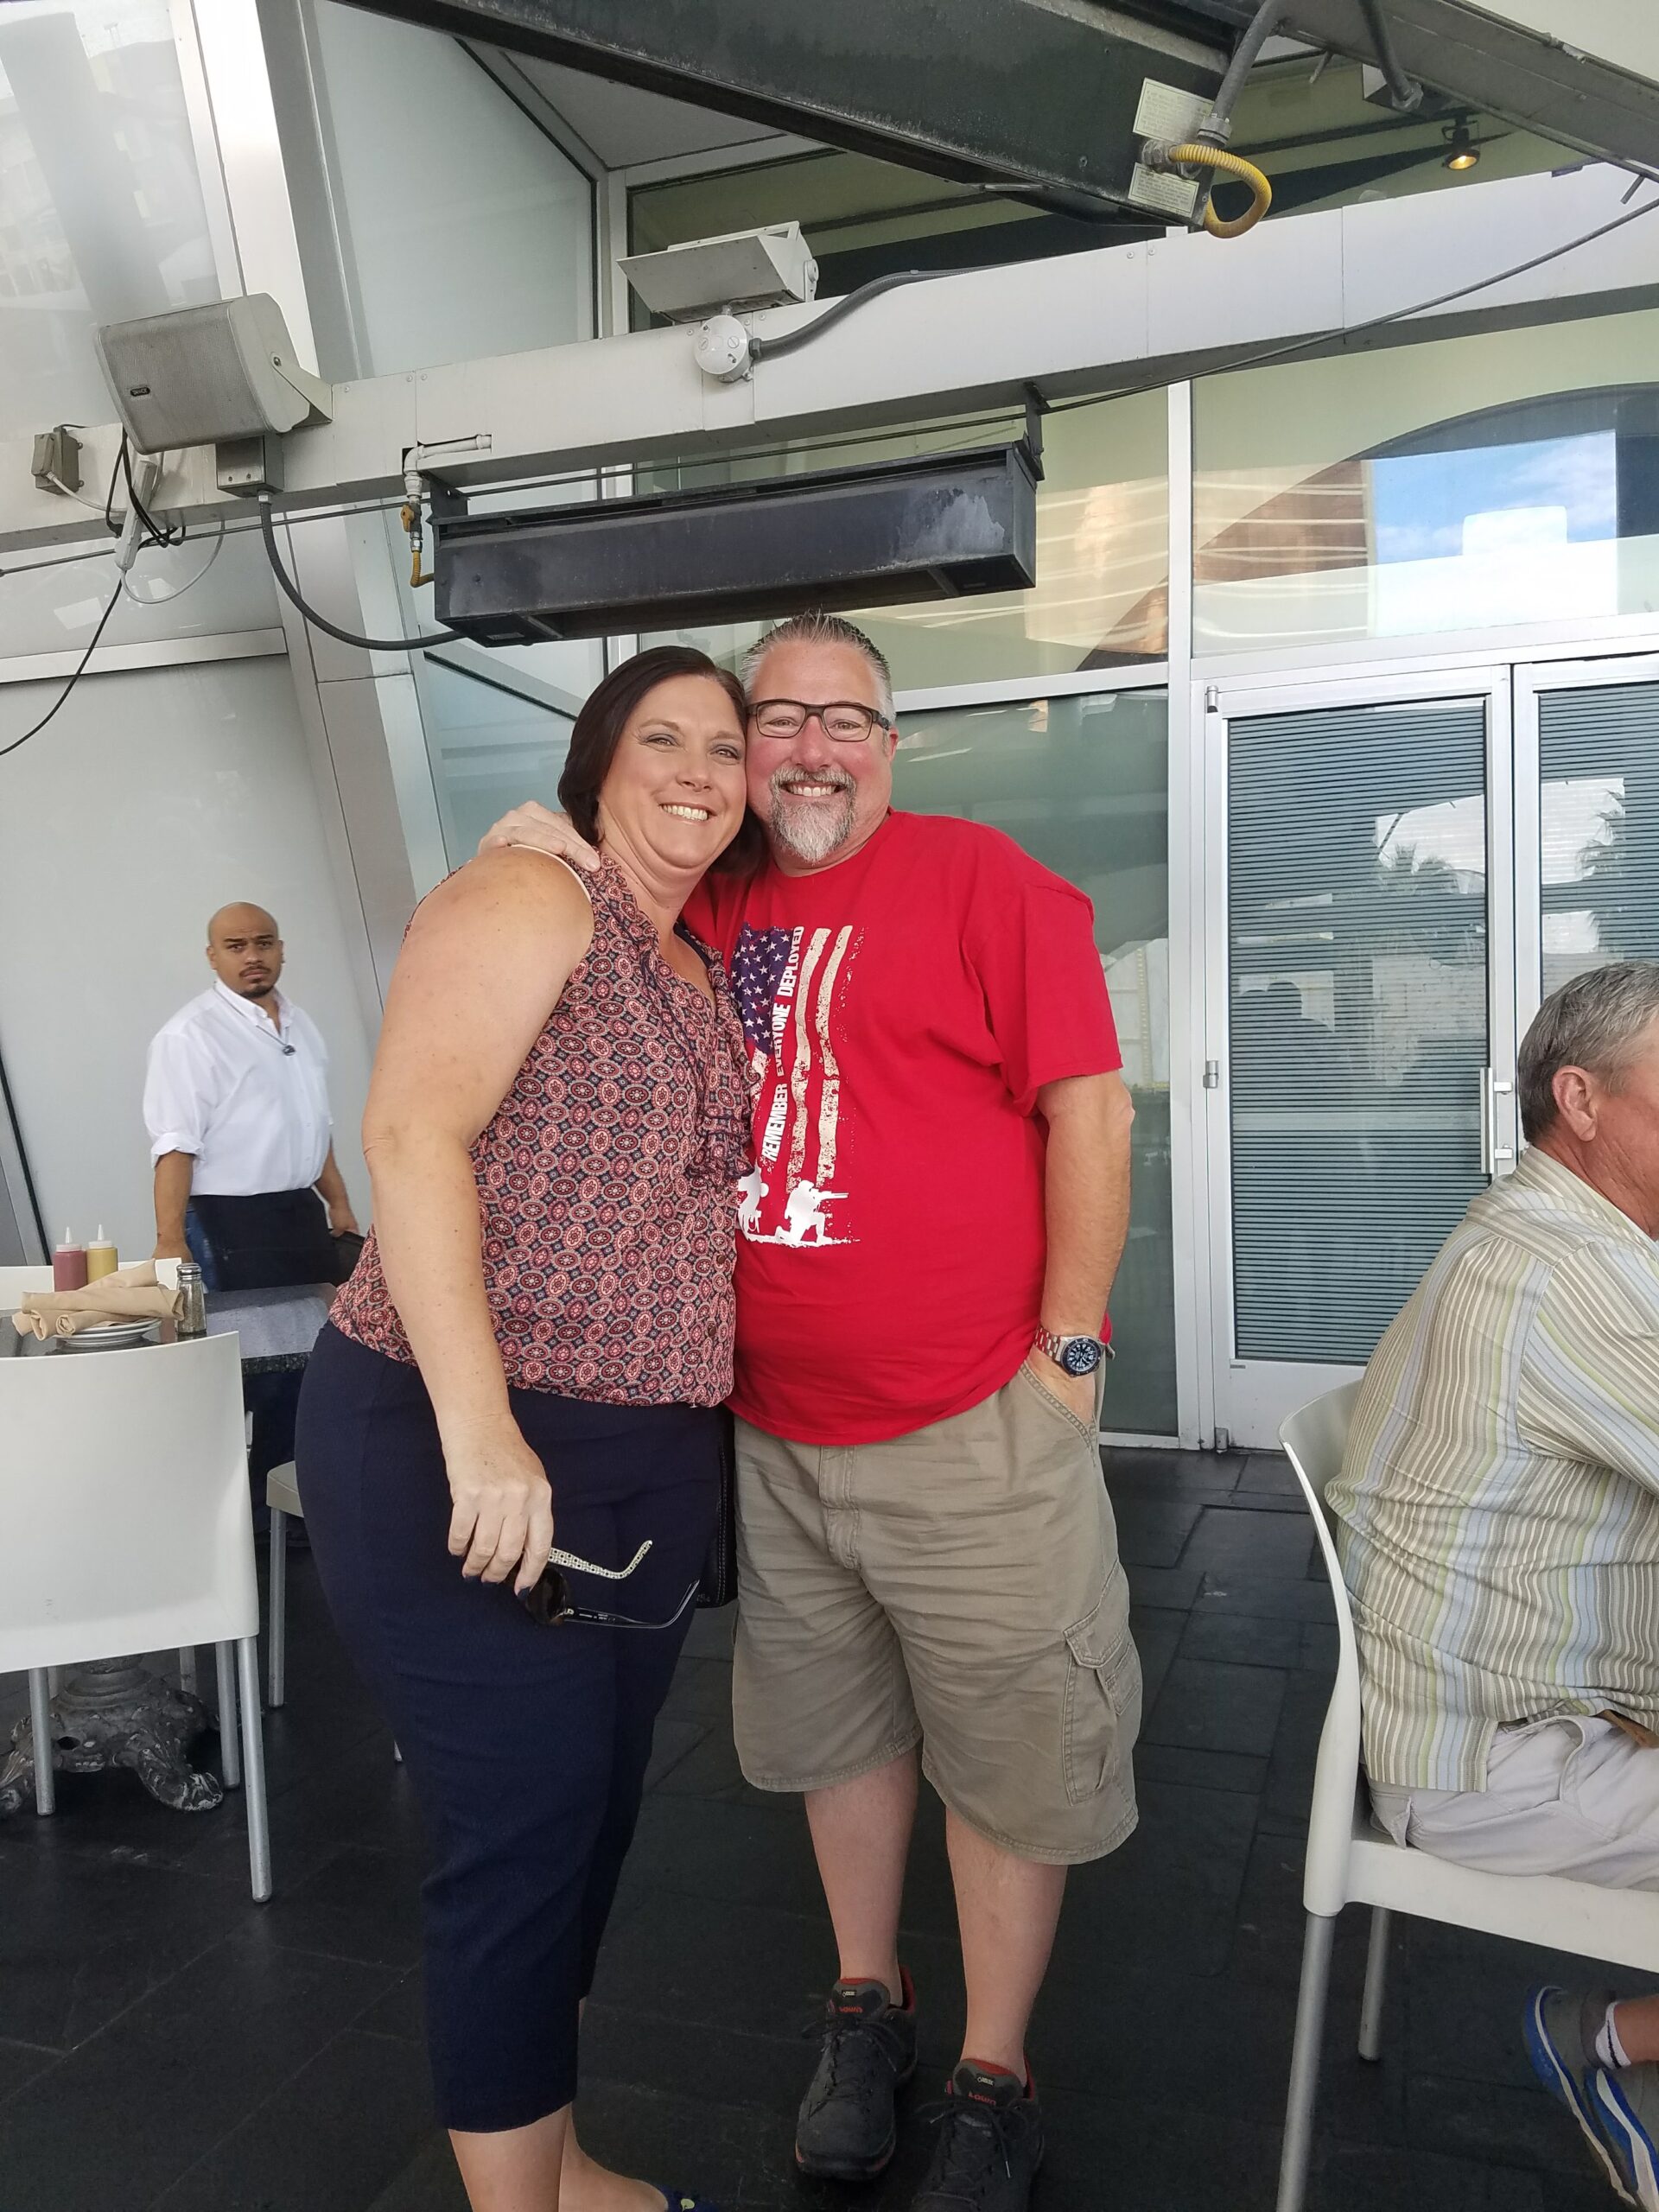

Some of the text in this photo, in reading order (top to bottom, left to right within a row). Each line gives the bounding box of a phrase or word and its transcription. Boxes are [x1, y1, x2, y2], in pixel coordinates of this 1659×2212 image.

[761, 925, 804, 1162] REMEMBER EVERYONE DEPLOYED
